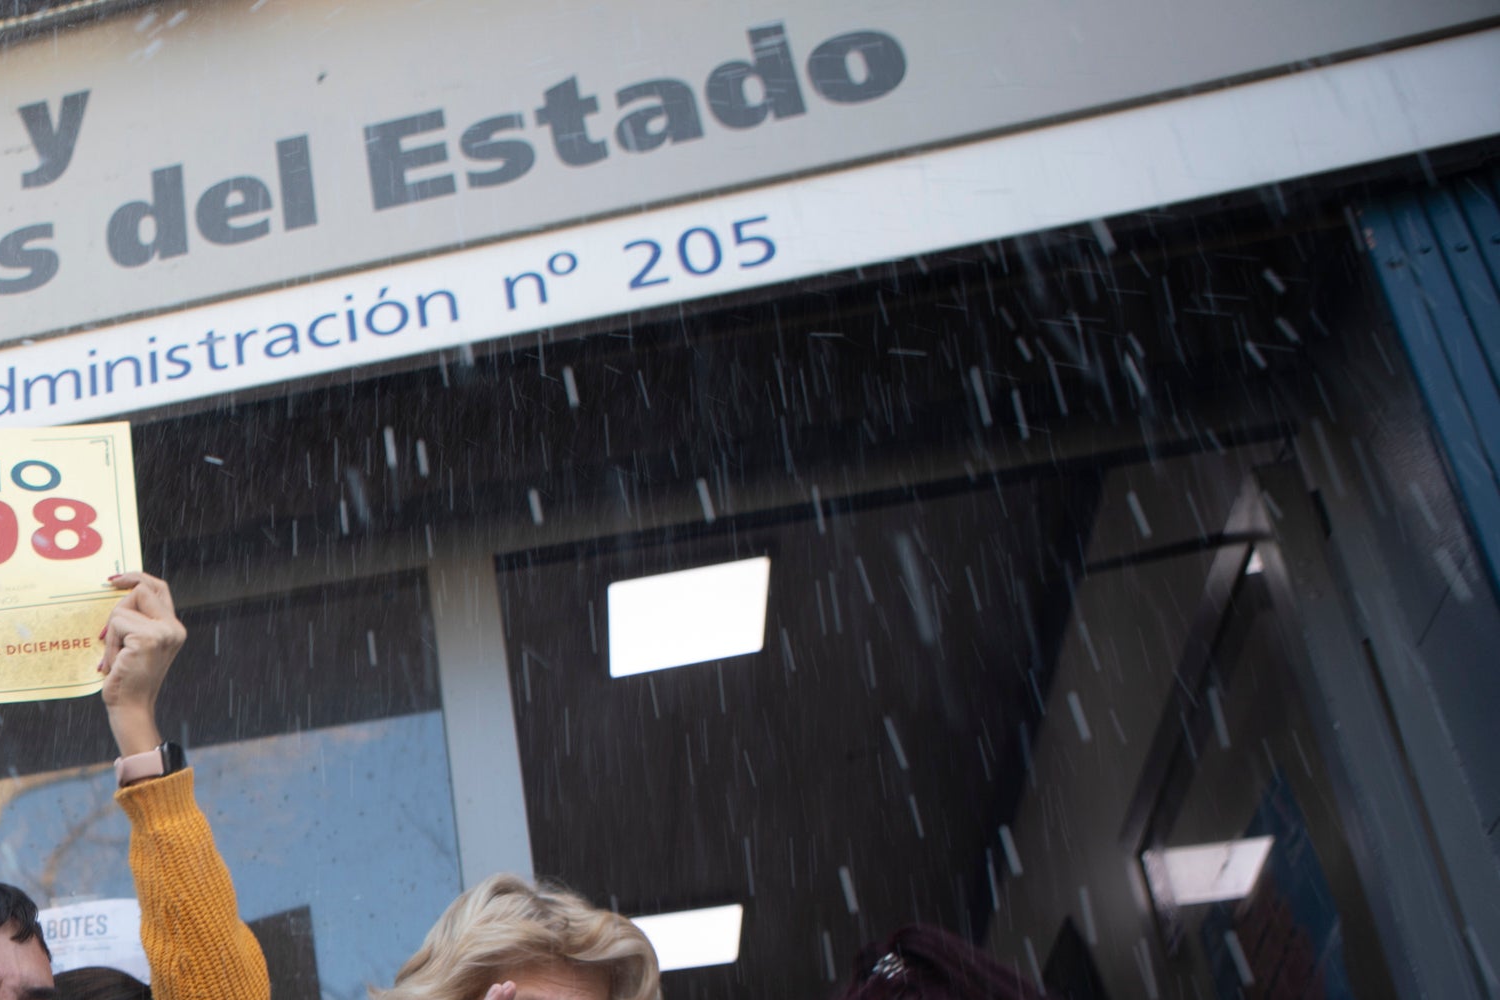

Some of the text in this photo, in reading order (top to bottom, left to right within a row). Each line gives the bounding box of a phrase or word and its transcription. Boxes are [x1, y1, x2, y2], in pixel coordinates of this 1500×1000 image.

[17, 89, 92, 189] y
[105, 135, 319, 268] del
[362, 22, 908, 211] Estado
[622, 215, 778, 290] 205
[6, 637, 92, 655] DICIEMBRE
[46, 914, 108, 940] BOTES
